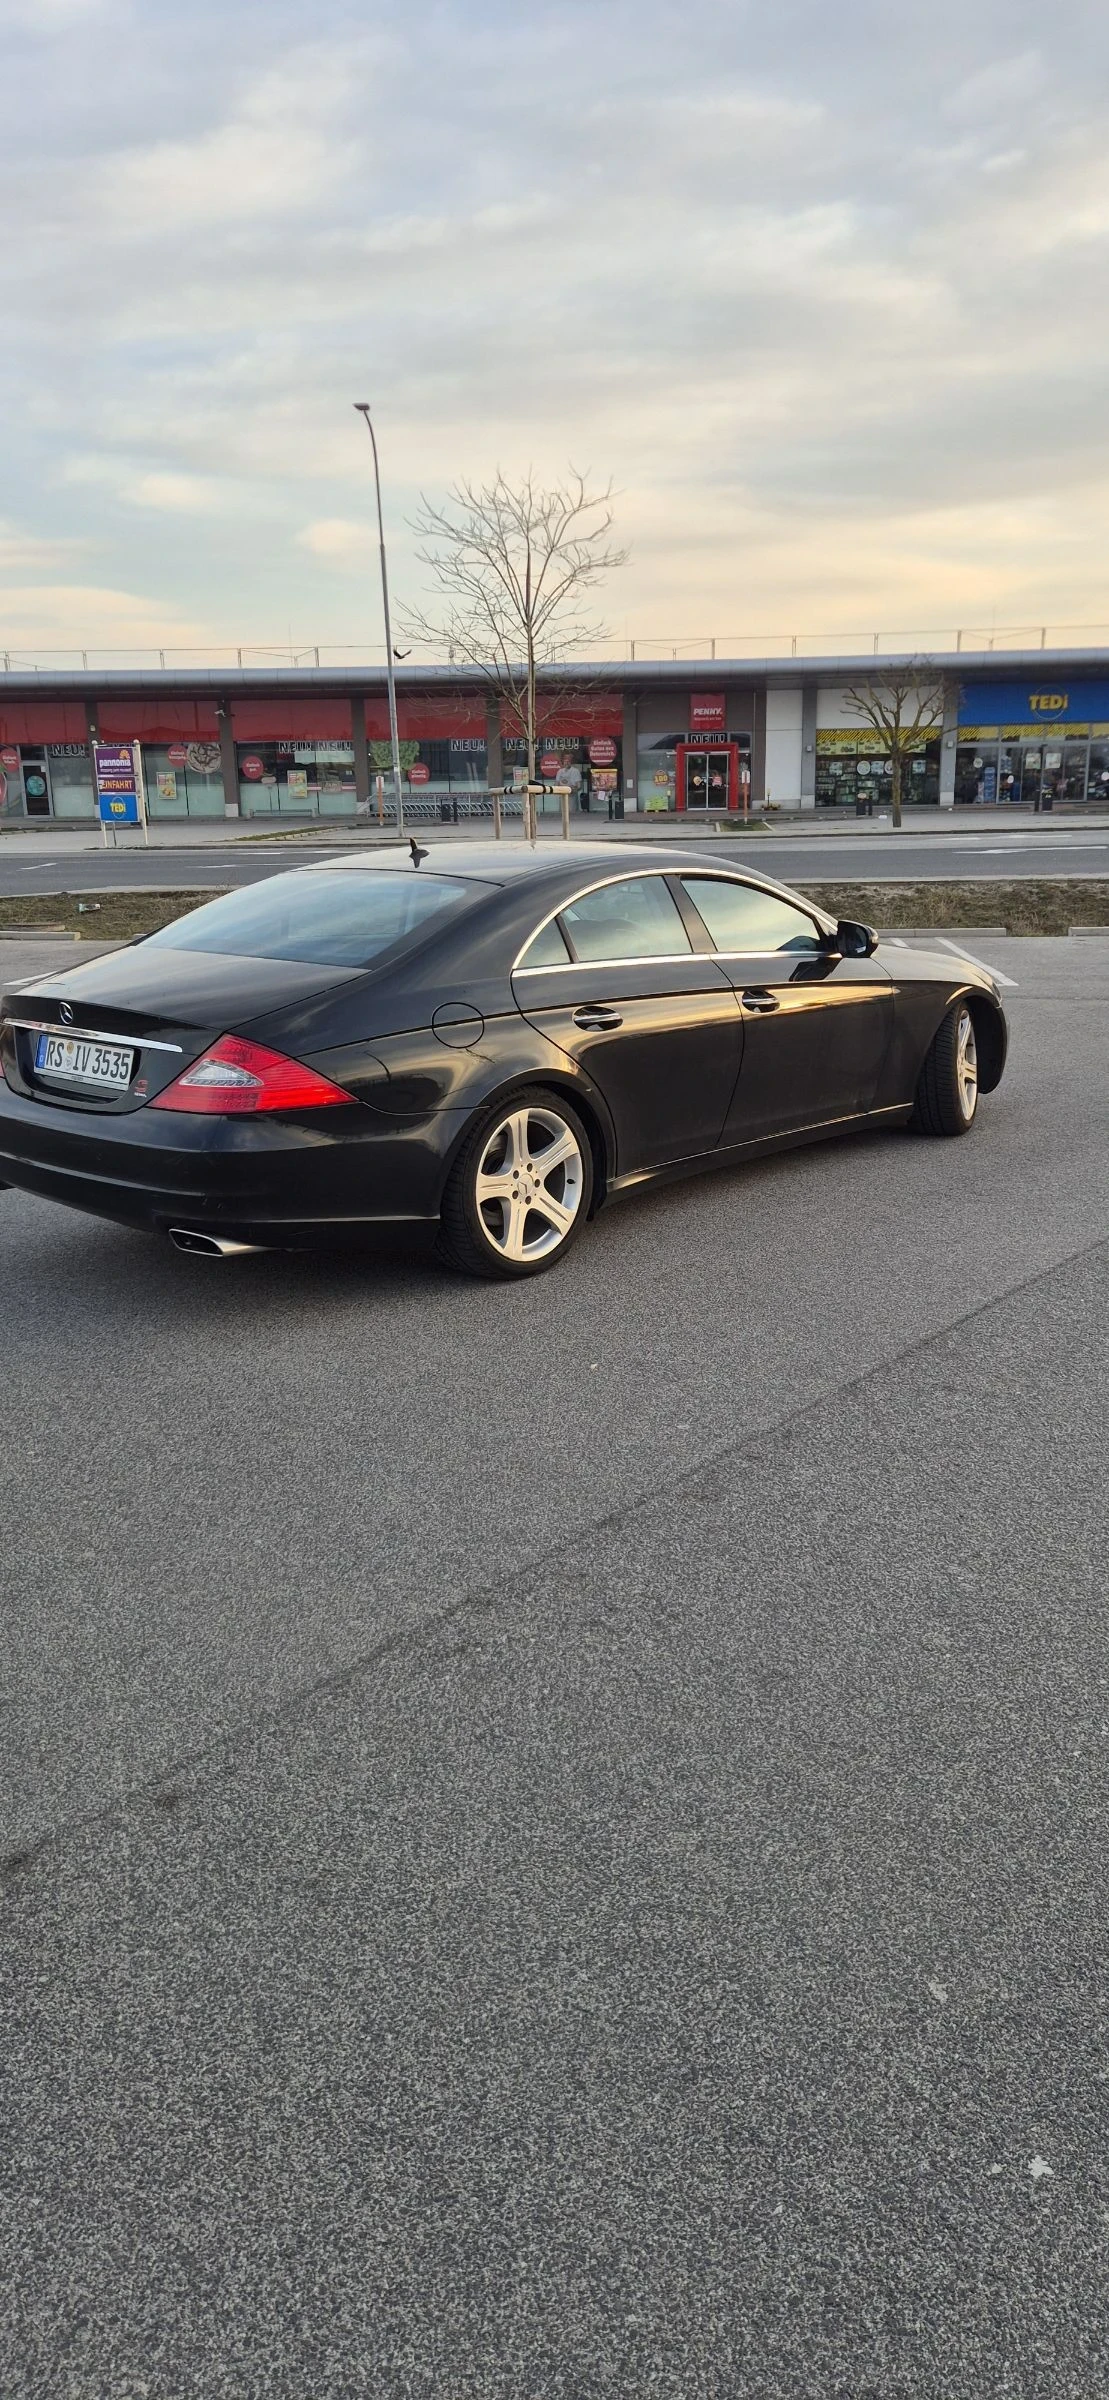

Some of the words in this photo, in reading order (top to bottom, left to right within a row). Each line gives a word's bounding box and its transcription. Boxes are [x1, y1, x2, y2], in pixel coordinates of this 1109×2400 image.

[450, 739, 485, 751] NEU!
[545, 737, 579, 750] NEU!
[52, 744, 86, 756] NEU!
[99, 759, 132, 768] pannonia
[102, 780, 133, 790] EINFAHRT
[46, 1041, 64, 1067] RS
[73, 1045, 91, 1072] IV
[92, 1048, 130, 1079] 3535
